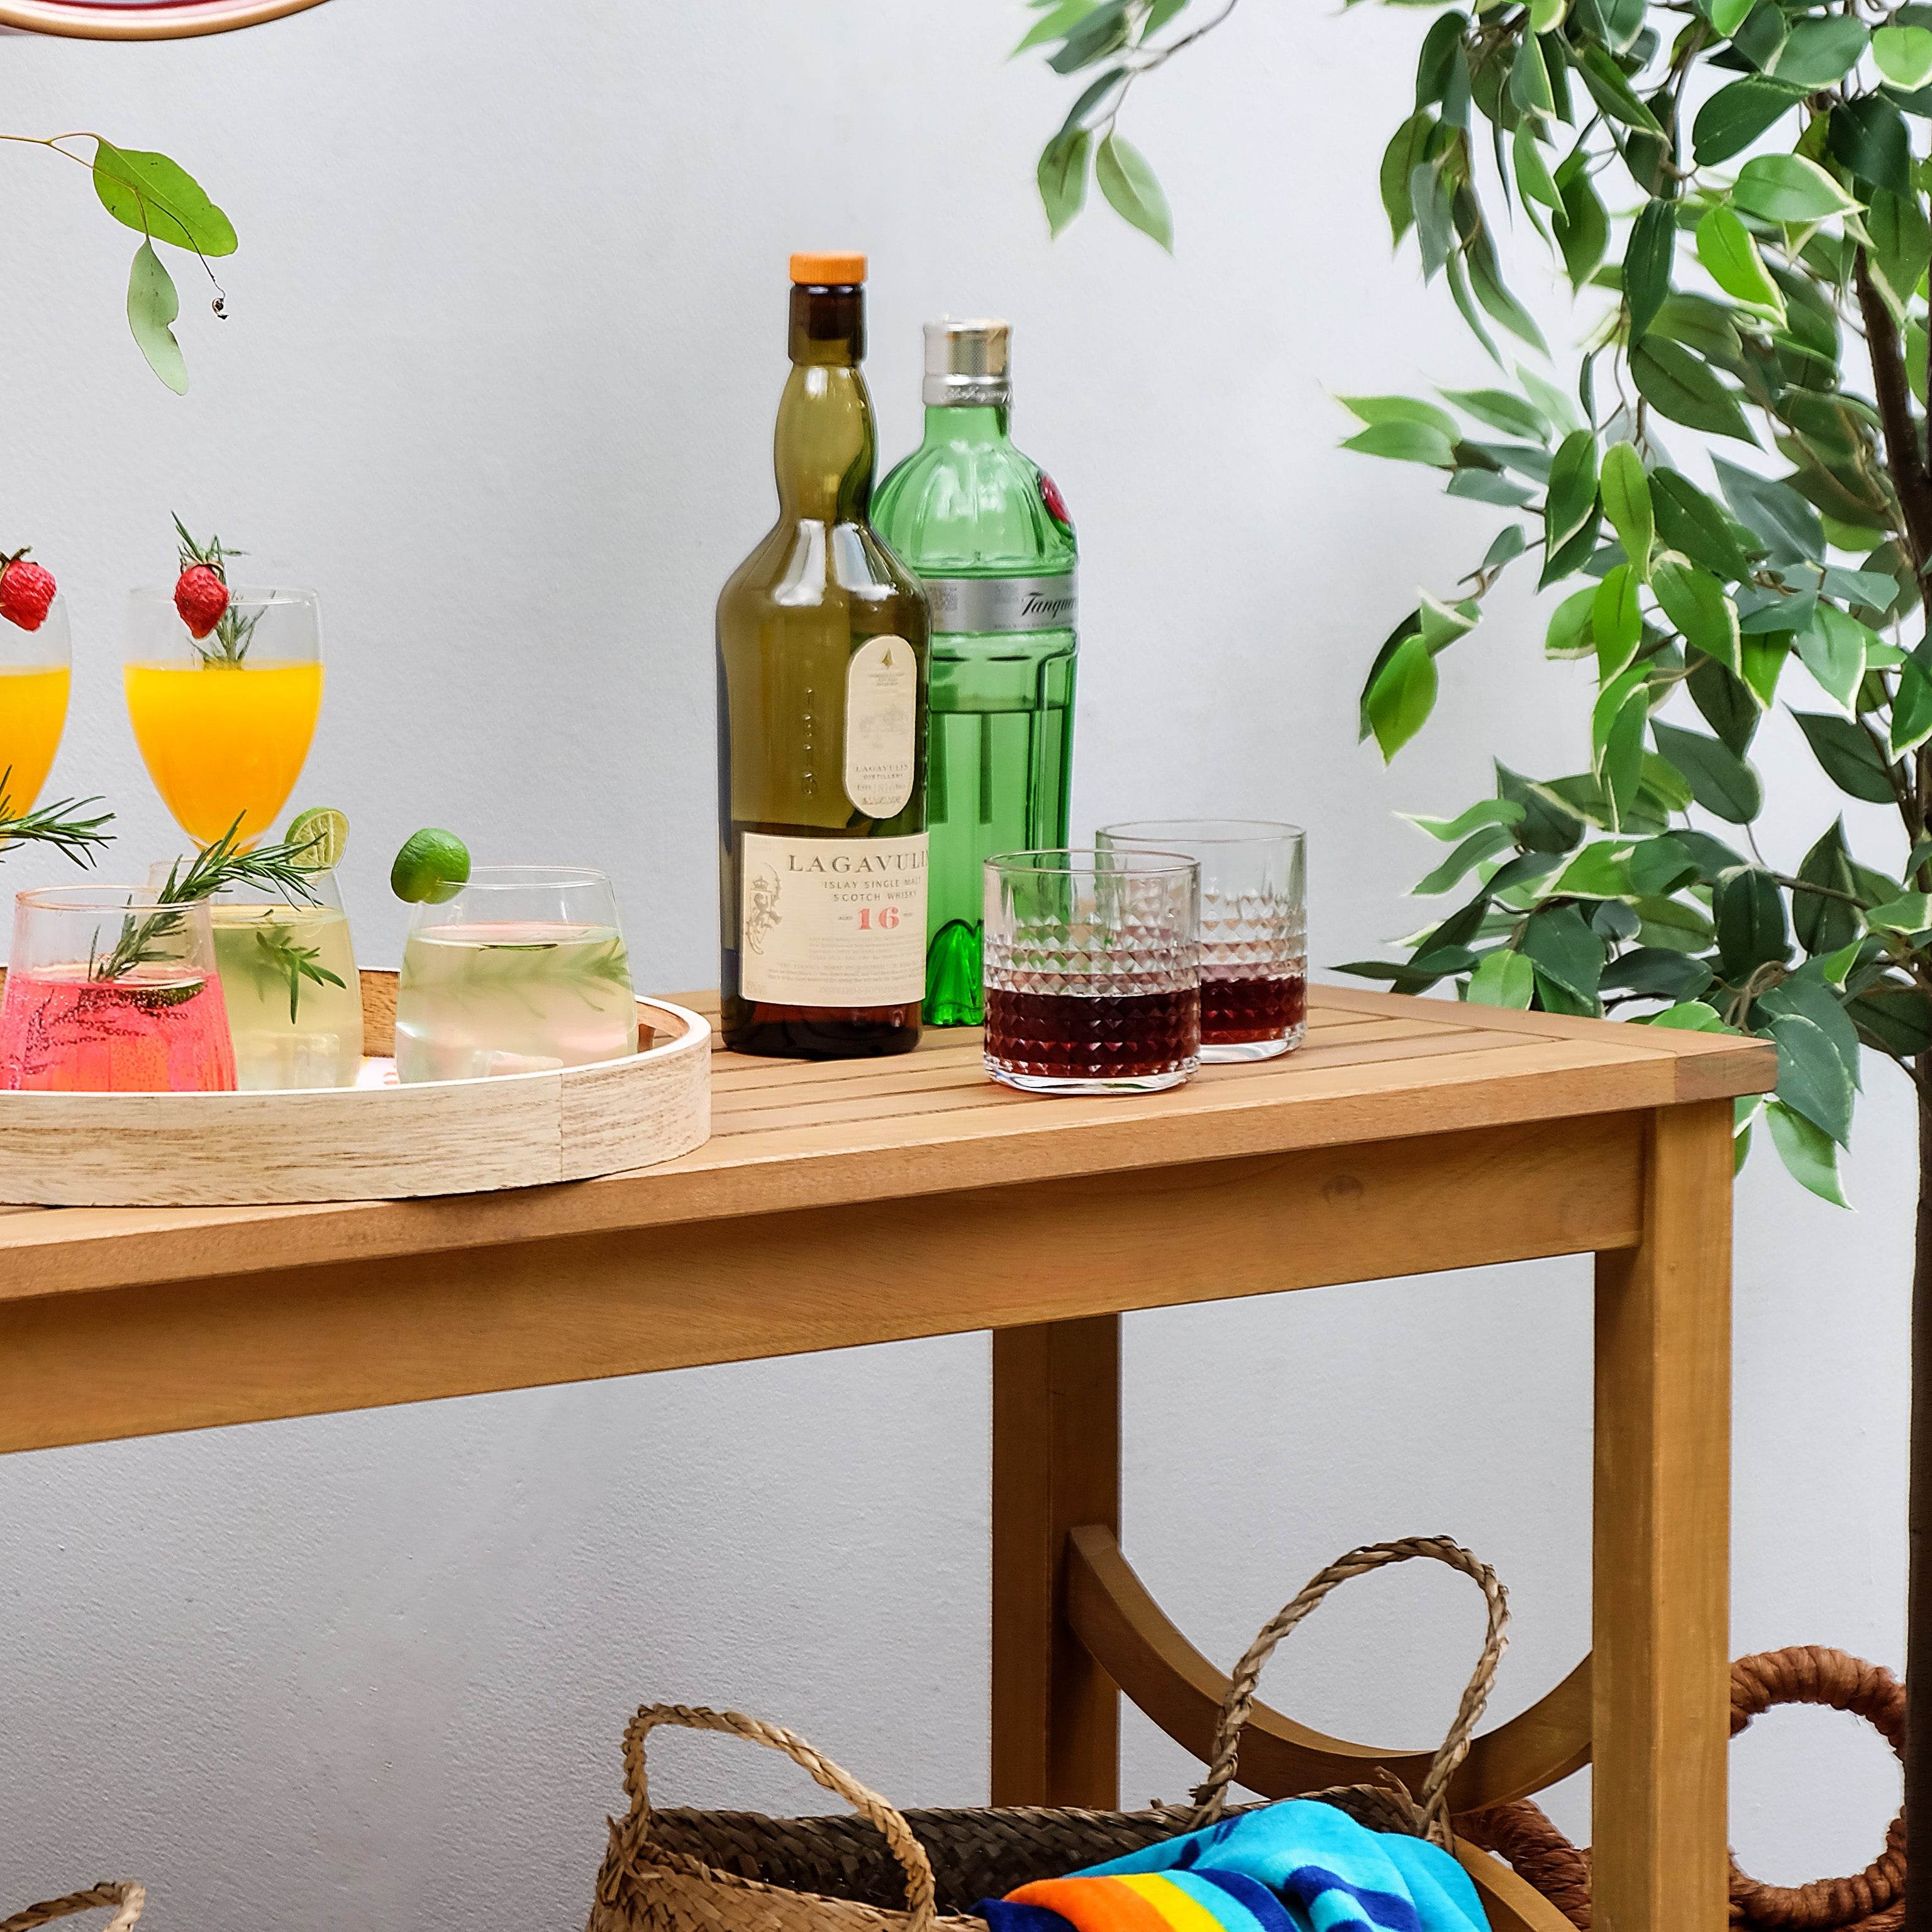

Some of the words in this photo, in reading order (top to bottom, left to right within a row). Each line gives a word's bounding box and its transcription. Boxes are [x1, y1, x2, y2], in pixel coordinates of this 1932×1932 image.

[824, 881, 858, 889] ISLAY
[864, 879, 899, 889] SINGLE
[833, 892, 880, 902] SCOTCH
[857, 906, 899, 930] 16
